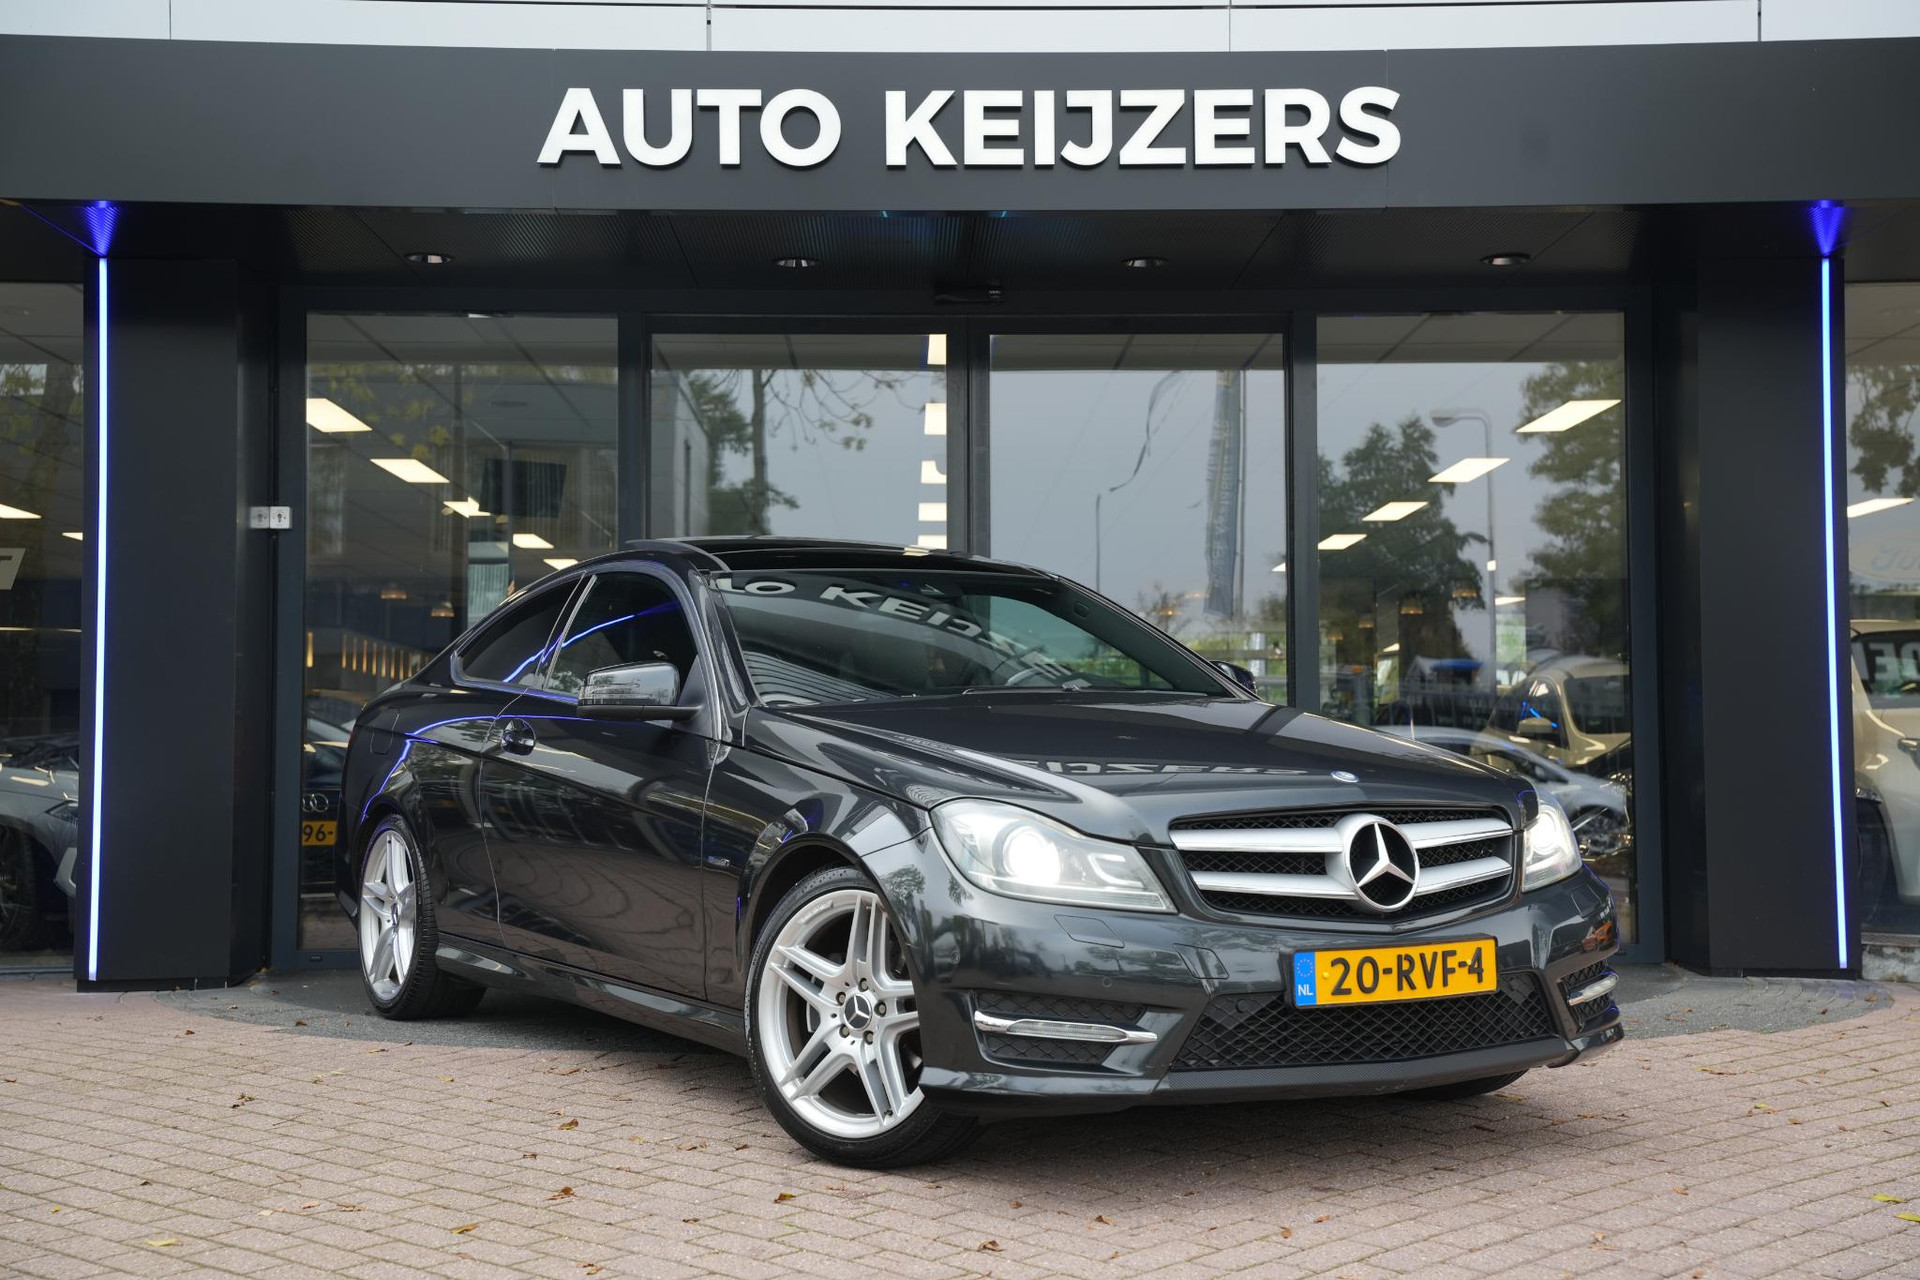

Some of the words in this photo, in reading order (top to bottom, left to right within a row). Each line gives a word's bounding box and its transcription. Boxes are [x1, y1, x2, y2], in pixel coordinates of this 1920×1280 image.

[537, 87, 842, 168] AUTO
[885, 86, 1401, 168] KEIJZERS
[1298, 984, 1313, 996] NL
[1331, 947, 1484, 996] 20-RVF-4
